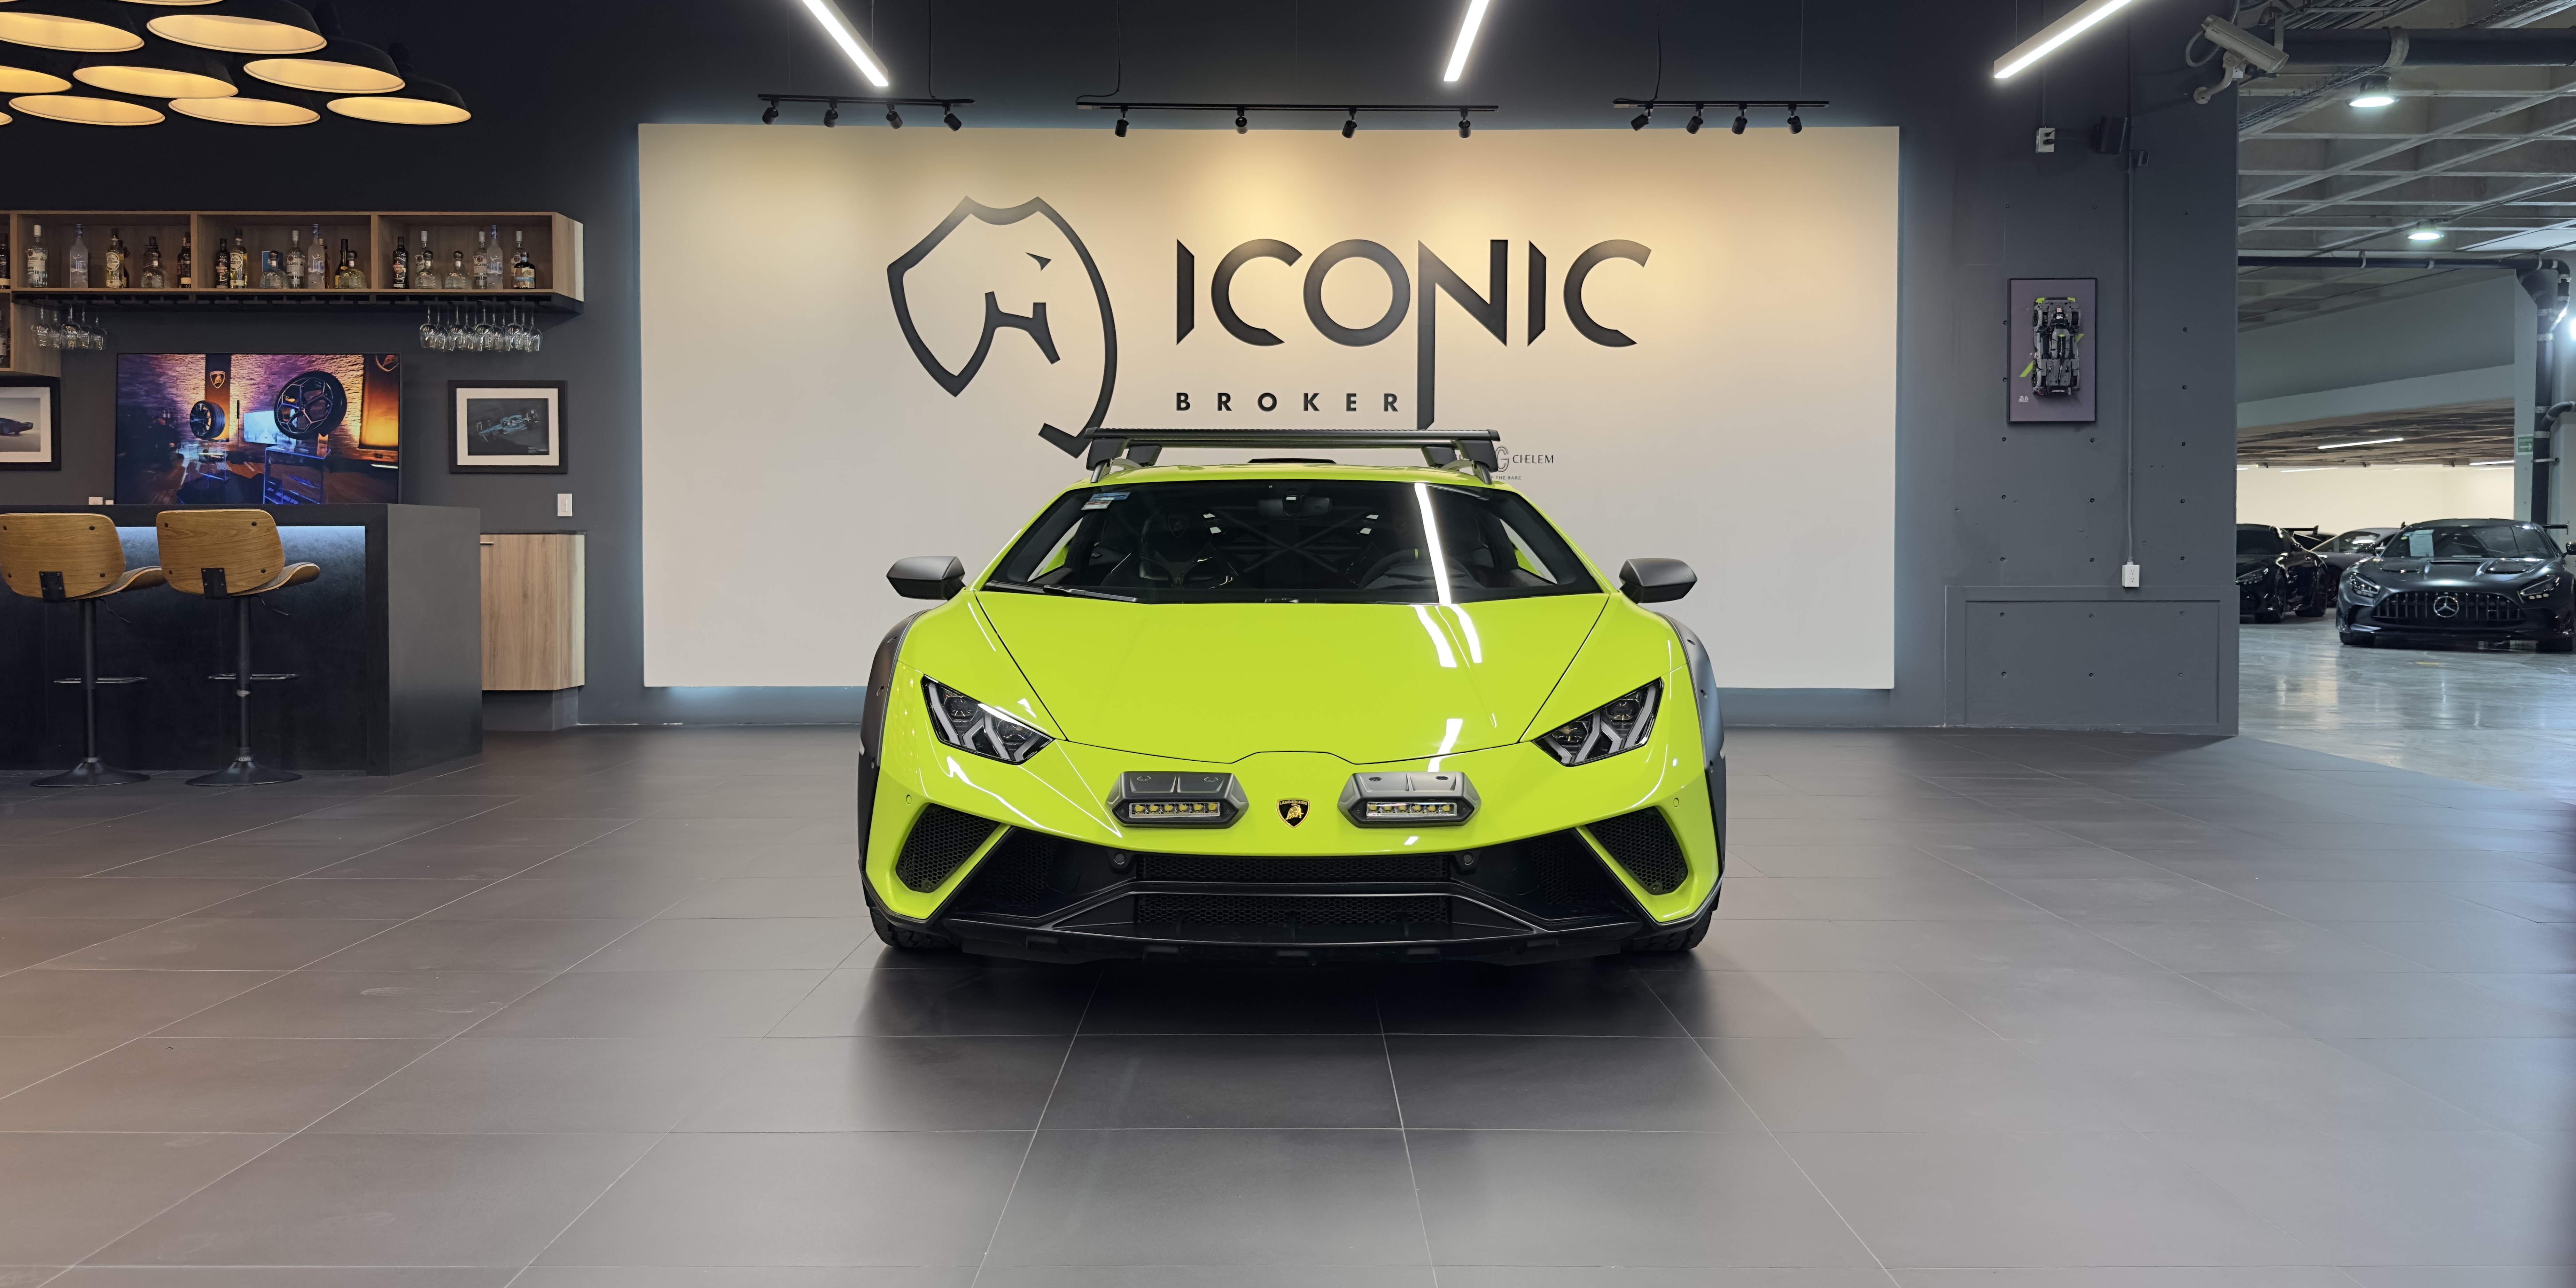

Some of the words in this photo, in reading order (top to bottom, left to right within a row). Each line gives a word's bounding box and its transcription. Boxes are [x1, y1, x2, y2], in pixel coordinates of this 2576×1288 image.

[1176, 239, 1652, 430] ICONIC
[1176, 392, 1398, 412] BROKER
[1512, 455, 1554, 464] CHELEM
